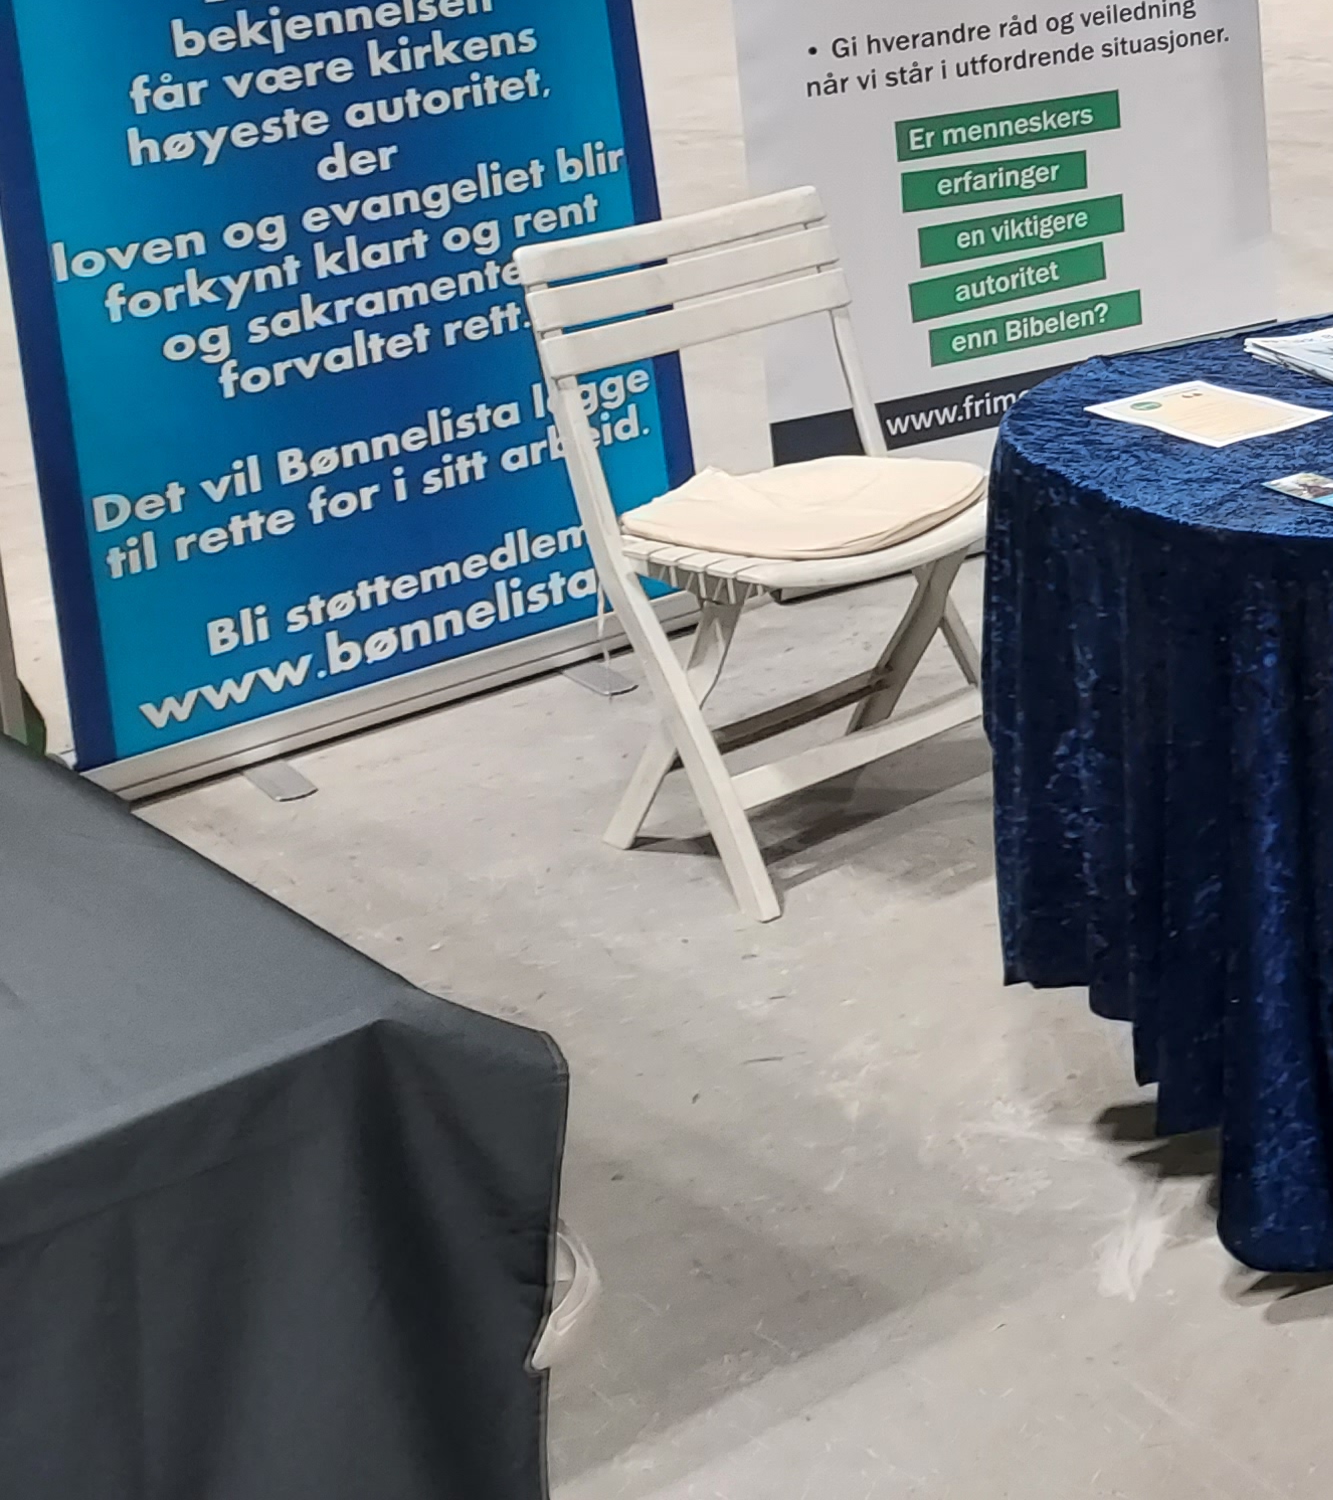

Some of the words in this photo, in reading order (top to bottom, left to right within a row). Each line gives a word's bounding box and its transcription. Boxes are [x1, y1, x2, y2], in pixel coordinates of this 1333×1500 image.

[866, 20, 991, 54] hverandre
[999, 12, 1038, 39] råd
[130, 69, 209, 116] får
[224, 54, 354, 101] være
[367, 24, 538, 79] kirkens
[806, 73, 850, 98] når
[885, 61, 934, 88] står
[955, 43, 1096, 79] utfordrende
[1101, 26, 1231, 60] situasjoner.
[127, 104, 331, 168] høyeste
[344, 66, 552, 130] autoritet,
[908, 127, 935, 152] Er
[942, 105, 1095, 147] menneskers
[316, 141, 399, 183] der
[937, 162, 1060, 197] erfaringer
[51, 226, 207, 283] loven
[222, 212, 288, 255] og
[302, 159, 545, 236] evangeliet
[555, 141, 626, 185] blir
[990, 208, 1089, 243] viktigere
[104, 257, 302, 325] forkynt
[314, 227, 429, 280] klart
[442, 218, 501, 257] og
[514, 193, 600, 239] rent
[954, 260, 1060, 303] autoritet
[162, 321, 232, 364] og
[218, 321, 431, 400] forvaltet
[443, 299, 532, 349] rett.
[950, 329, 999, 354] enn
[1004, 302, 1110, 343] Bibelen?
[886, 389, 1029, 436] www.frim
[91, 481, 186, 533] Det
[199, 455, 263, 504] vil
[277, 400, 522, 487] Bønnelista
[531, 368, 650, 420] lgge
[106, 535, 157, 579] til
[174, 505, 297, 562] rette
[307, 478, 382, 526] for
[422, 451, 488, 496] sitt
[206, 606, 271, 657] Bli
